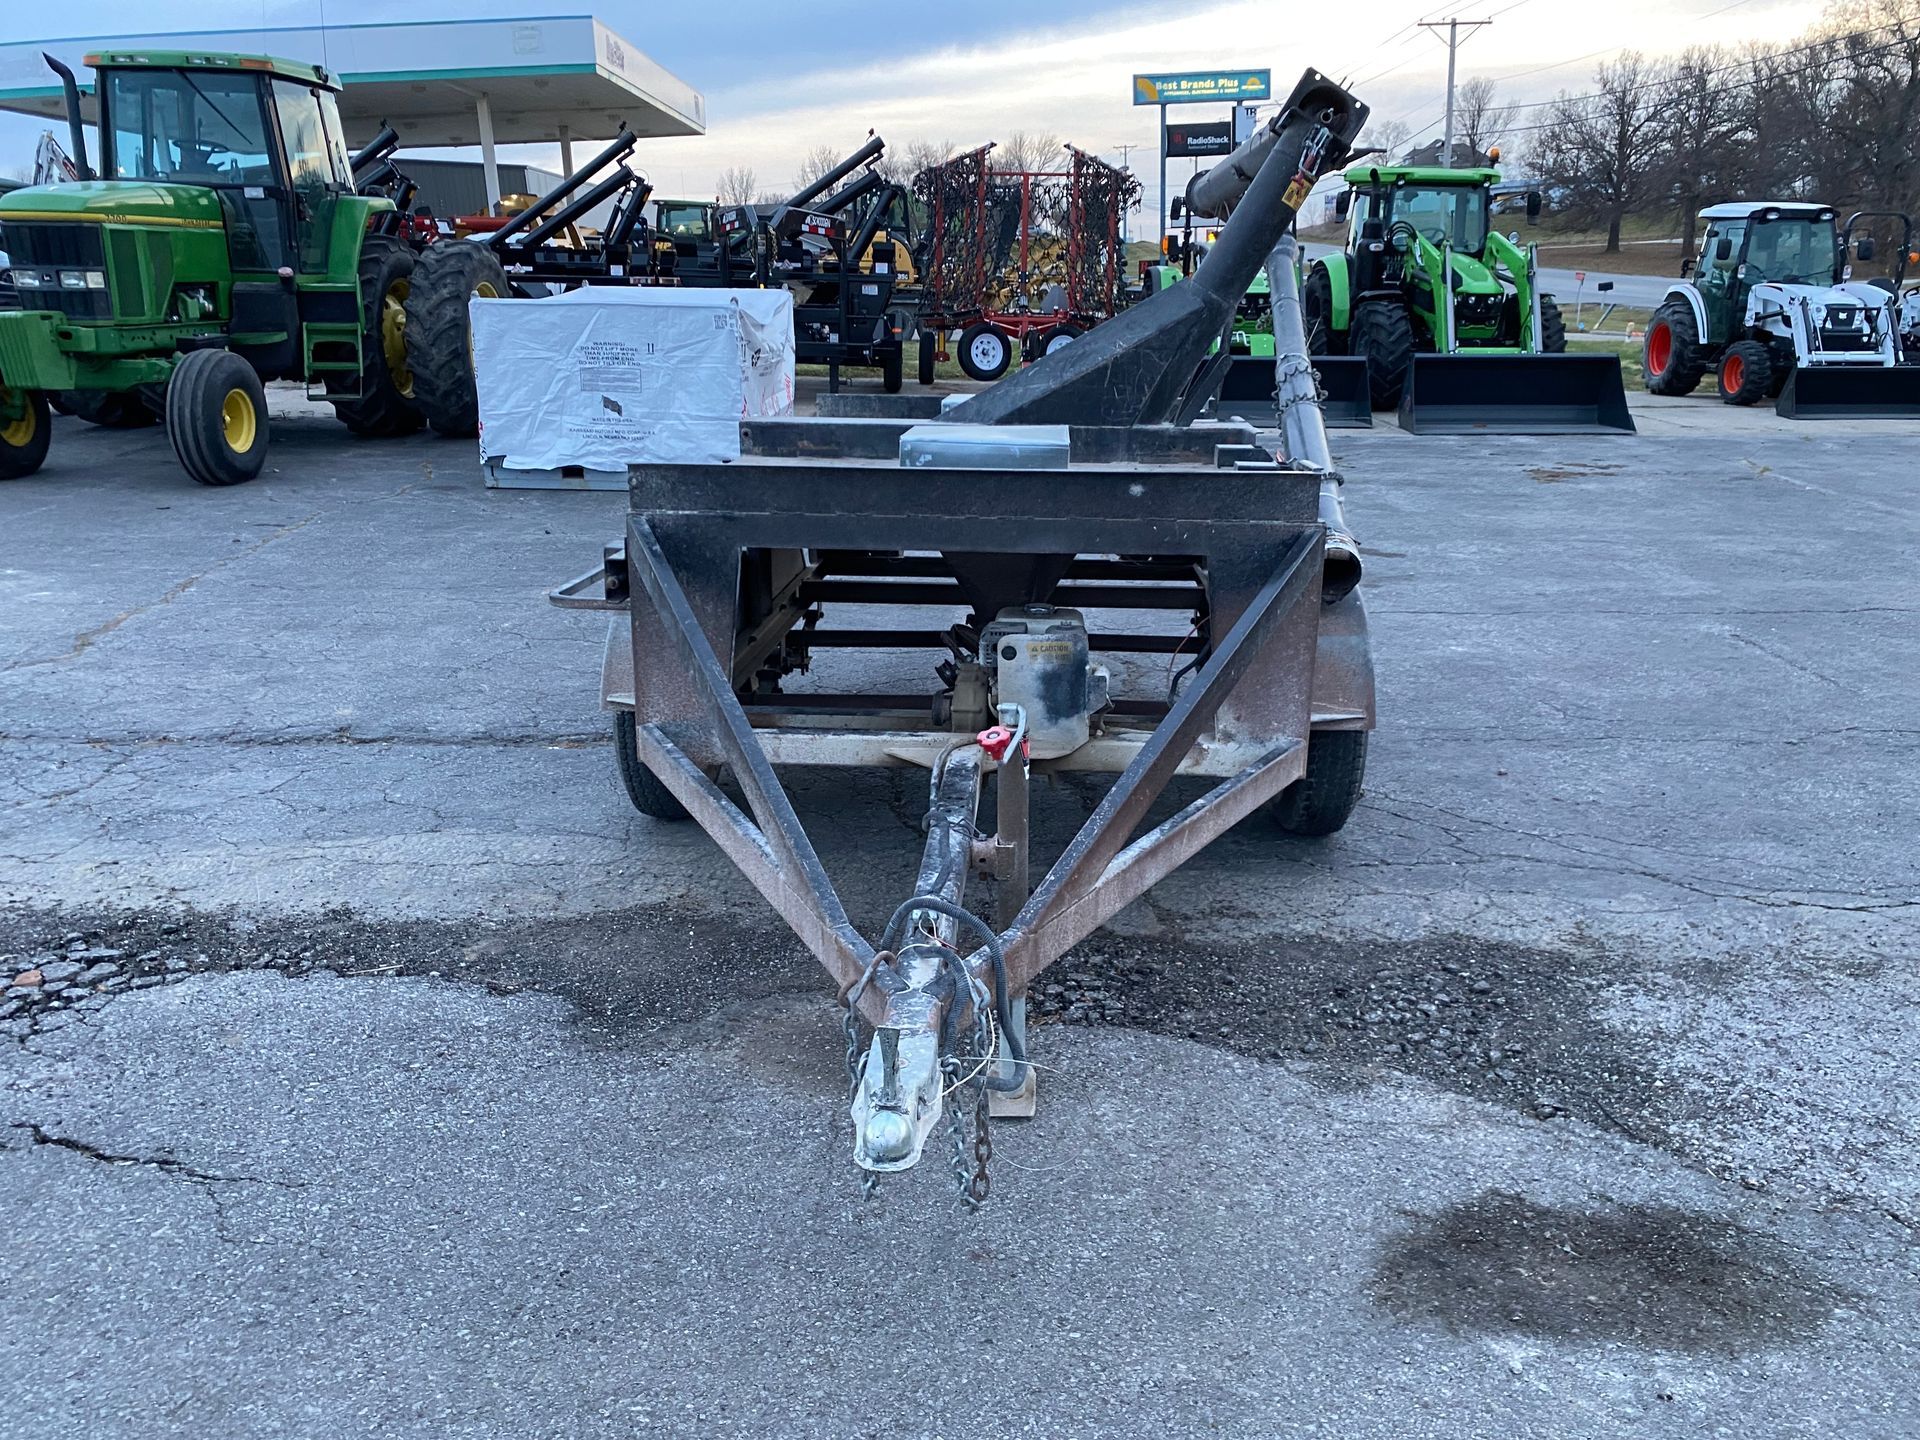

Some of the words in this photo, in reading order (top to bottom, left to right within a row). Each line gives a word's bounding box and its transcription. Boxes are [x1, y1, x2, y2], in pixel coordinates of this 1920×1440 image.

[1155, 81, 1178, 90] Best
[1180, 80, 1215, 89] Brands
[1218, 79, 1239, 87] Plus
[1187, 135, 1229, 145] RadioShack
